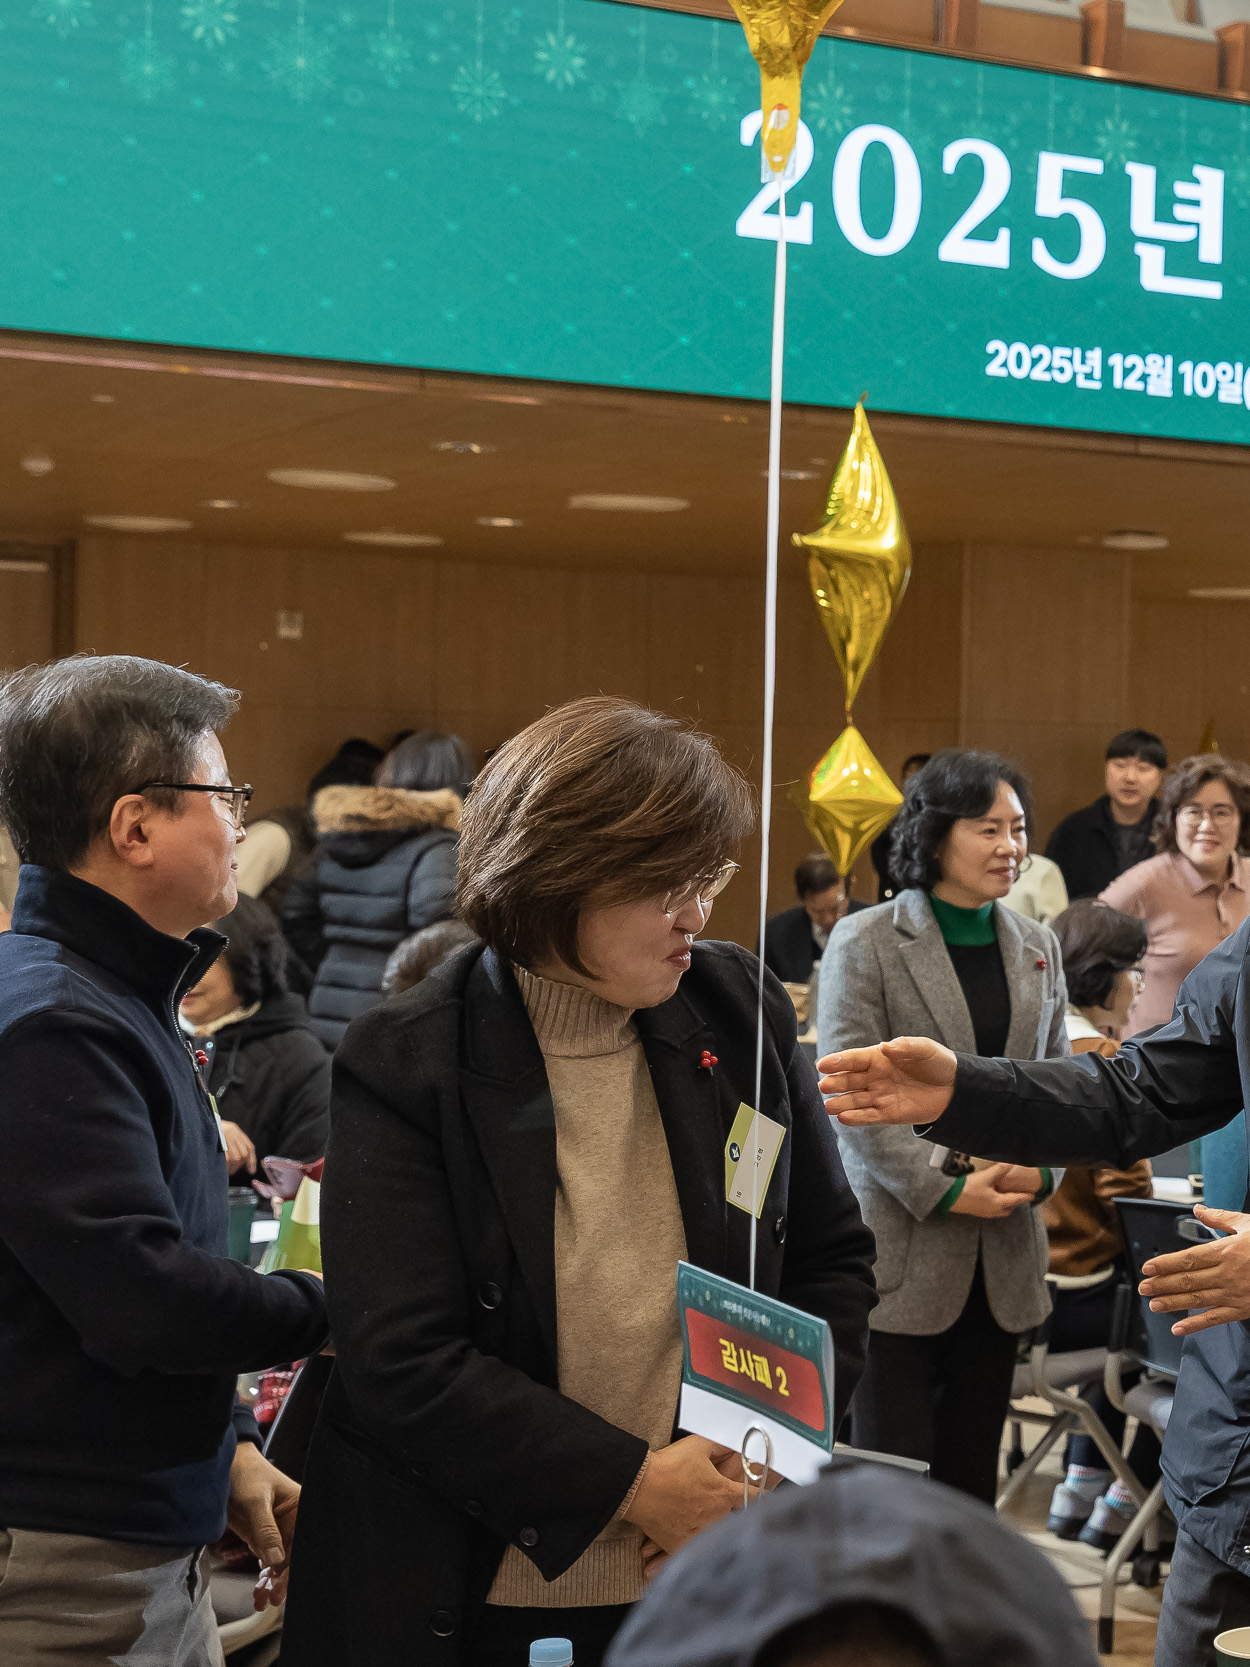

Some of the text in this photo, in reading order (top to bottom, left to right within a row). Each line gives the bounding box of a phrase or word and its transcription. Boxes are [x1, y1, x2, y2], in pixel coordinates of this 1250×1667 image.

[736, 108, 1225, 301] 2025년
[985, 339, 1102, 390] 2025년
[1108, 353, 1173, 398] 12월
[718, 1337, 791, 1398] 감사패 2
